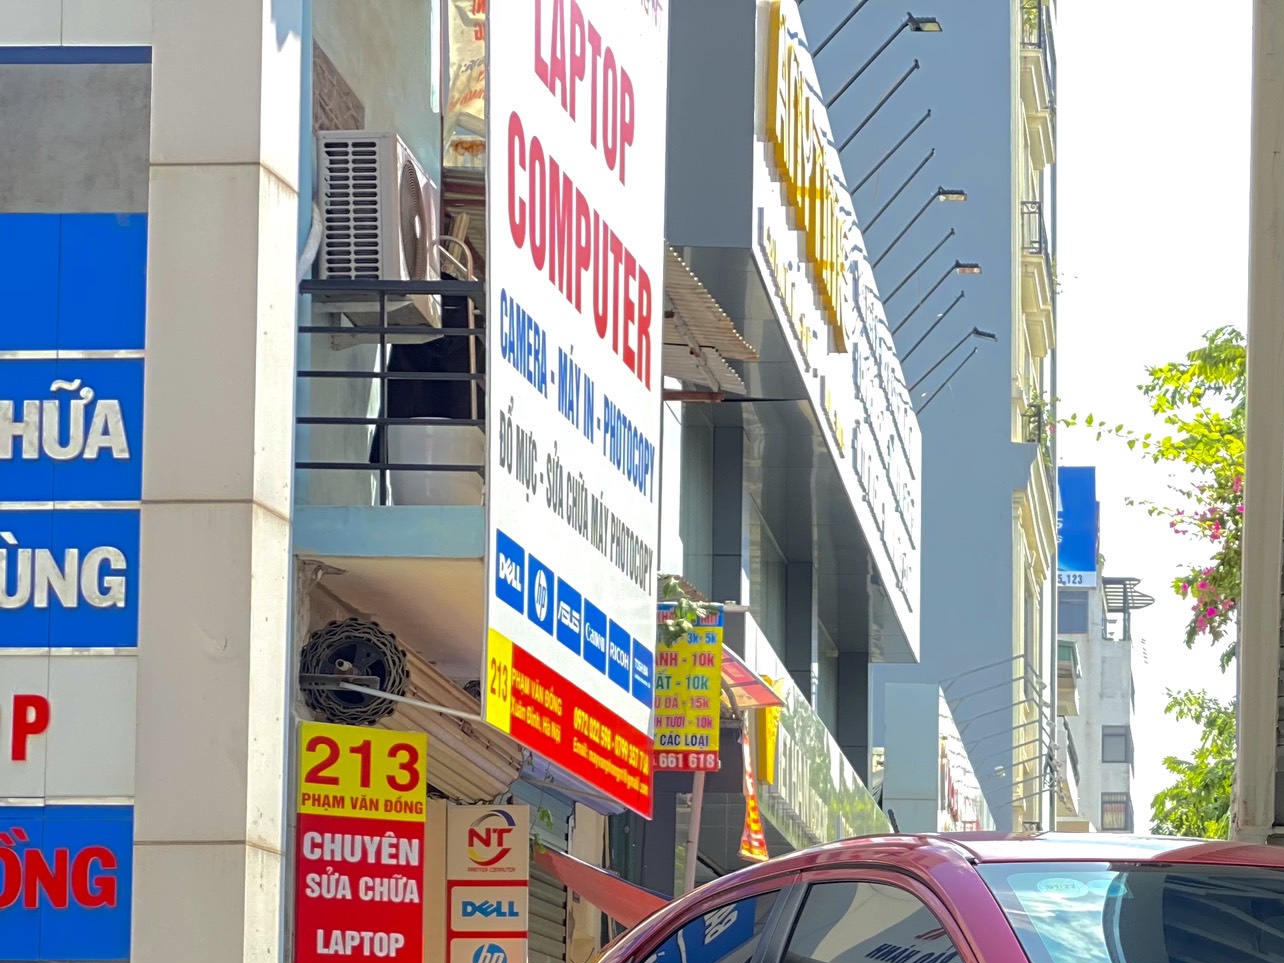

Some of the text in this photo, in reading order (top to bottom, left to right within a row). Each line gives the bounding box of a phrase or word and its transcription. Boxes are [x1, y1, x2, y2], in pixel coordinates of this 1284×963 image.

[535, 0, 635, 187] LAPTOP
[507, 110, 652, 392] COMPUTER
[500, 288, 548, 399] CAMERA
[558, 344, 582, 430] MÁY
[584, 372, 594, 445] IN
[603, 393, 656, 504] PHOTOCOPY
[0, 379, 130, 460] HỮA
[499, 395, 514, 474] ĐỔ
[516, 423, 538, 503] MỰC
[546, 439, 564, 520] SỬA
[566, 471, 589, 541] CHỮA
[591, 491, 609, 558] MÁY
[610, 512, 654, 597] PHOTOCOPY
[498, 552, 522, 592] DELL
[535, 570, 547, 621] hp
[558, 600, 580, 634] ASUS
[585, 622, 605, 652] Canon
[610, 641, 629, 671] RICOH
[692, 652, 714, 666] 10k
[489, 656, 509, 702] 213
[686, 675, 708, 690] 10k
[690, 697, 709, 709] 15k
[696, 716, 713, 728] 10k
[660, 731, 709, 750] CÁC LOẠI
[304, 735, 420, 792] 213
[659, 753, 715, 768] 661 618
[301, 792, 345, 811] PHẠM
[350, 794, 379, 812] VĂN
[303, 831, 419, 866] CHUYÊN
[468, 827, 514, 848] NT
[305, 866, 419, 903] SỬA CHỮA
[462, 900, 519, 918] DELL
[317, 929, 405, 958] LAPTOP
